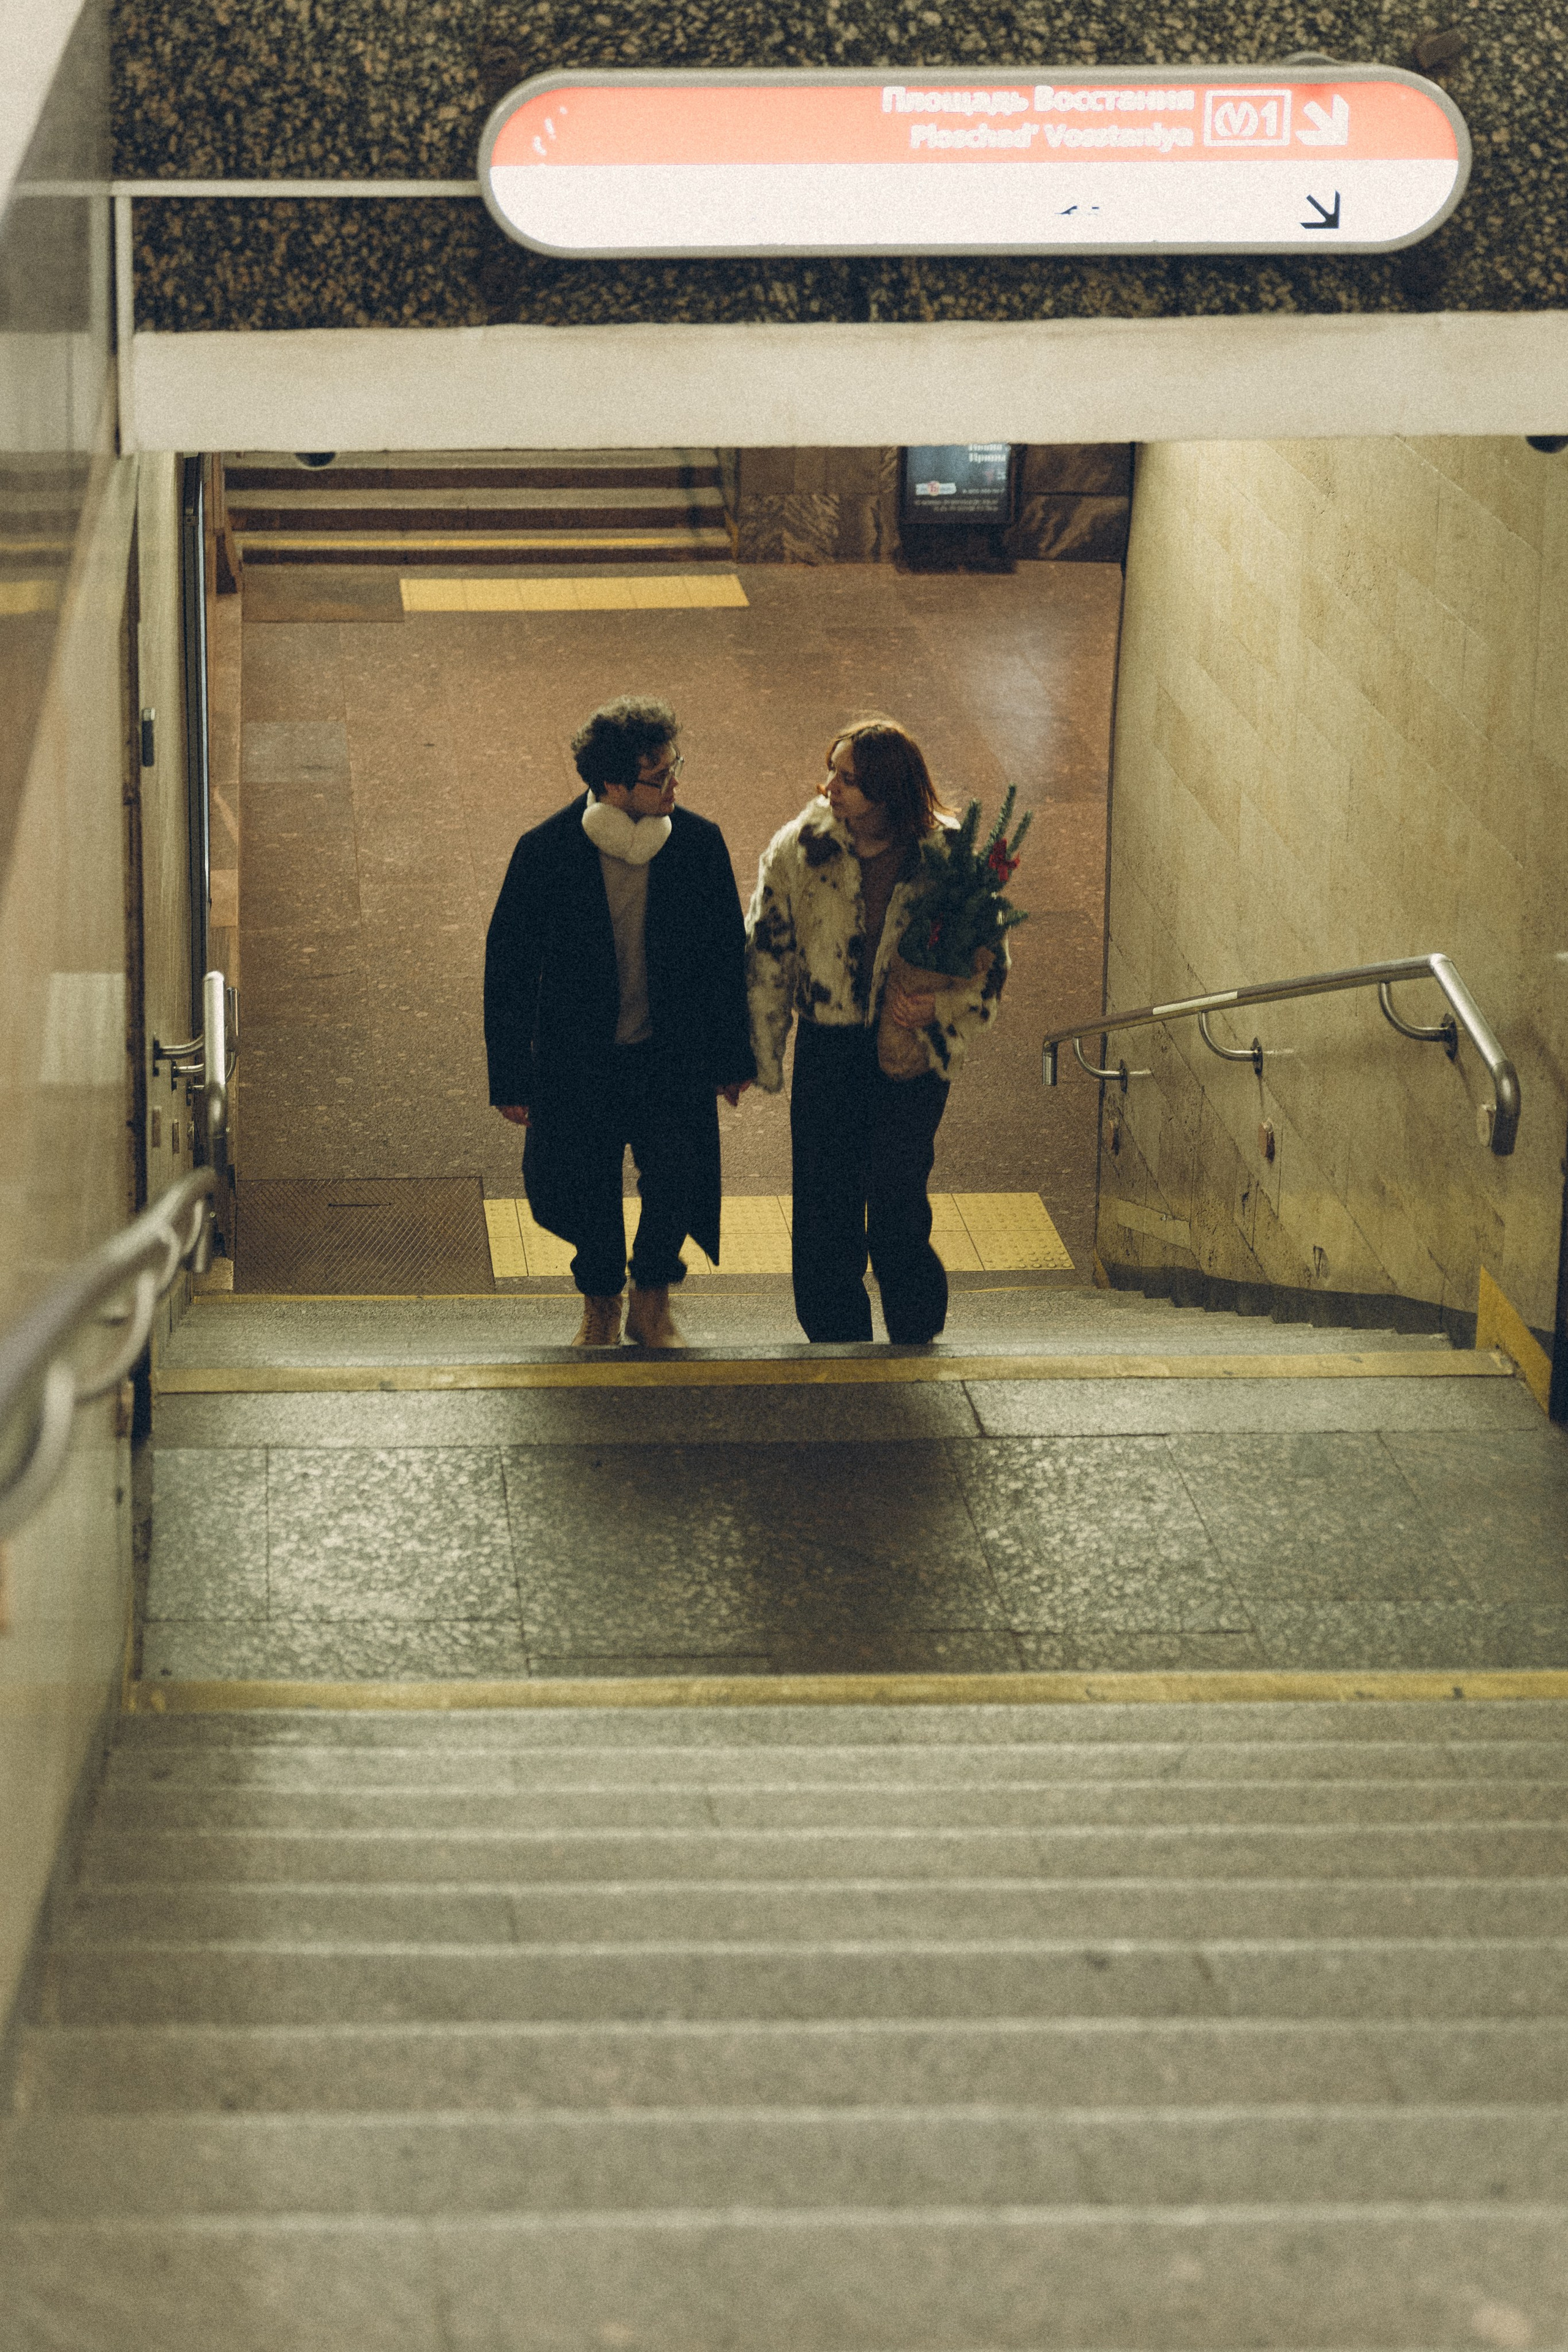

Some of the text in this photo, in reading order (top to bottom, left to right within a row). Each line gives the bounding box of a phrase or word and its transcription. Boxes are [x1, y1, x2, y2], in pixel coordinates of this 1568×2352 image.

[882, 85, 1194, 116] Площадь Восстания
[1043, 122, 1194, 153] Vosstaniya
